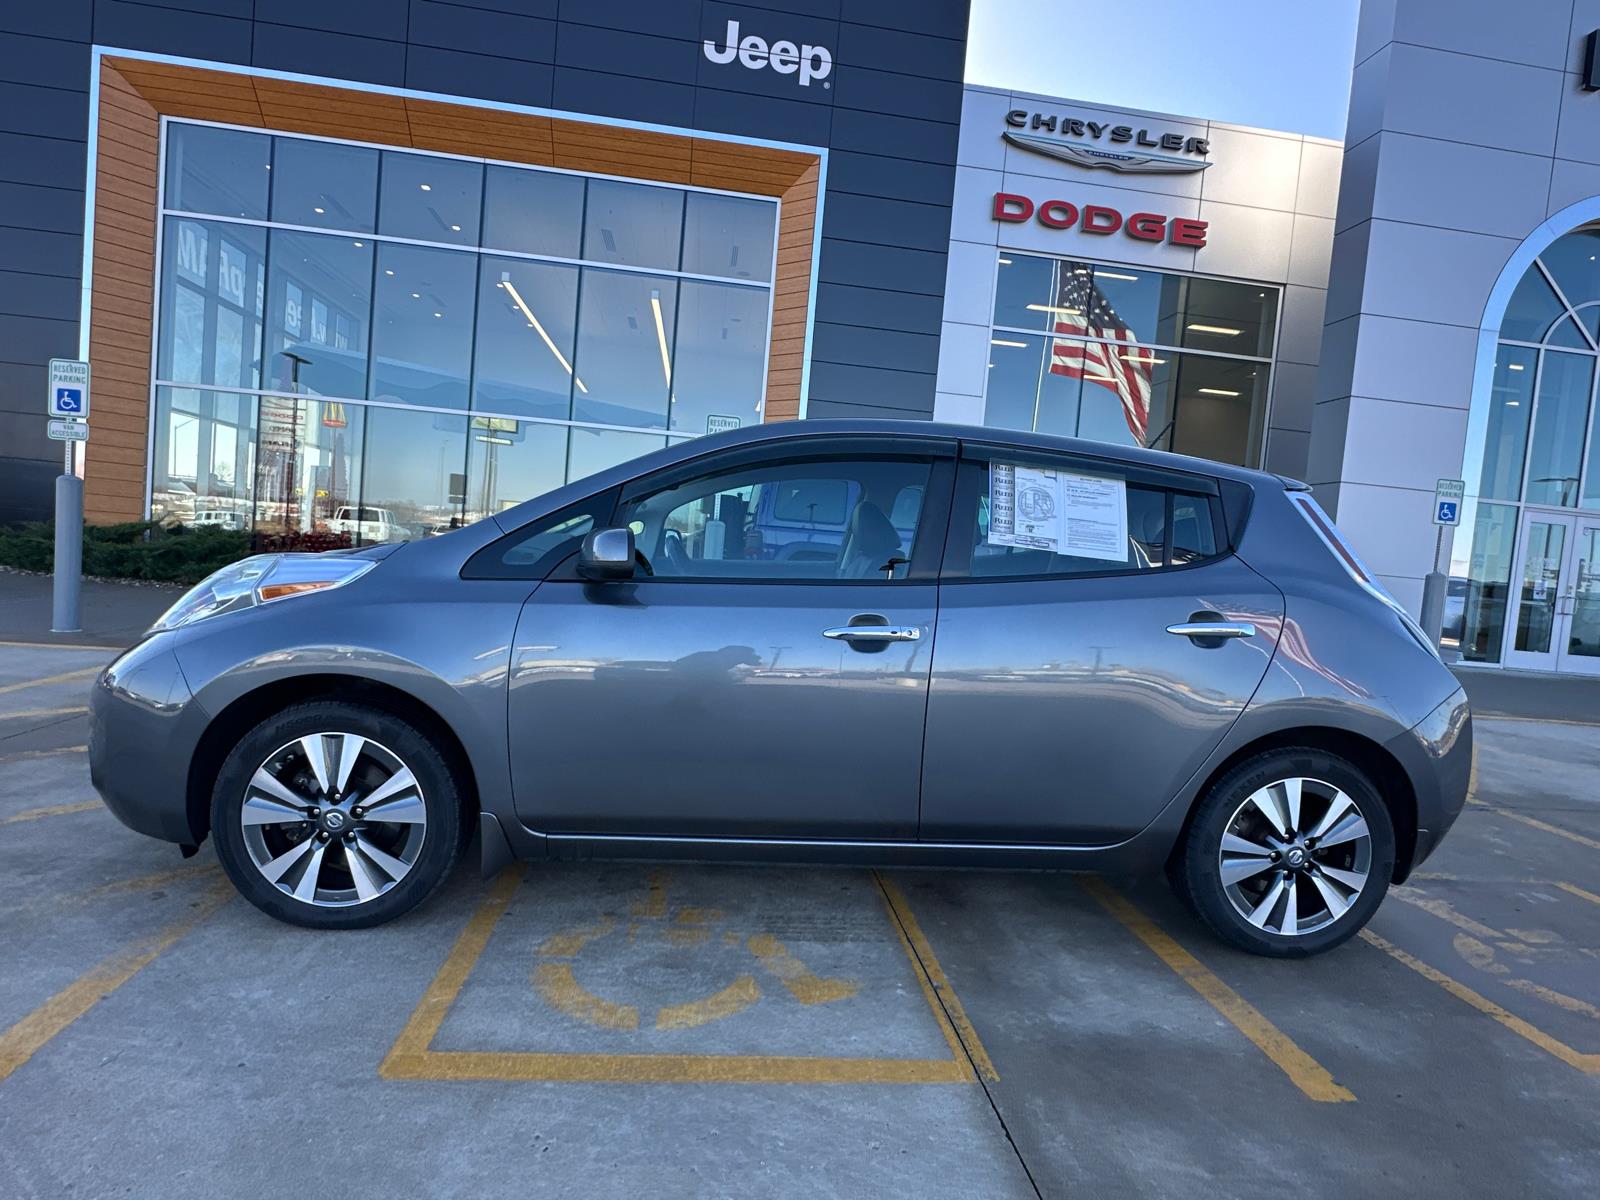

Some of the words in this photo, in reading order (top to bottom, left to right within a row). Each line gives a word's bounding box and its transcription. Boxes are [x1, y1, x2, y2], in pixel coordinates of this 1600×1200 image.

[704, 20, 832, 87] Jeep
[1006, 109, 1210, 155] CHRYSLER
[992, 192, 1209, 249] DODGE
[53, 363, 86, 374] RESERVED
[53, 374, 86, 384] PARKING
[710, 419, 737, 428] RESERVED
[51, 430, 86, 438] ACCESSIBLE
